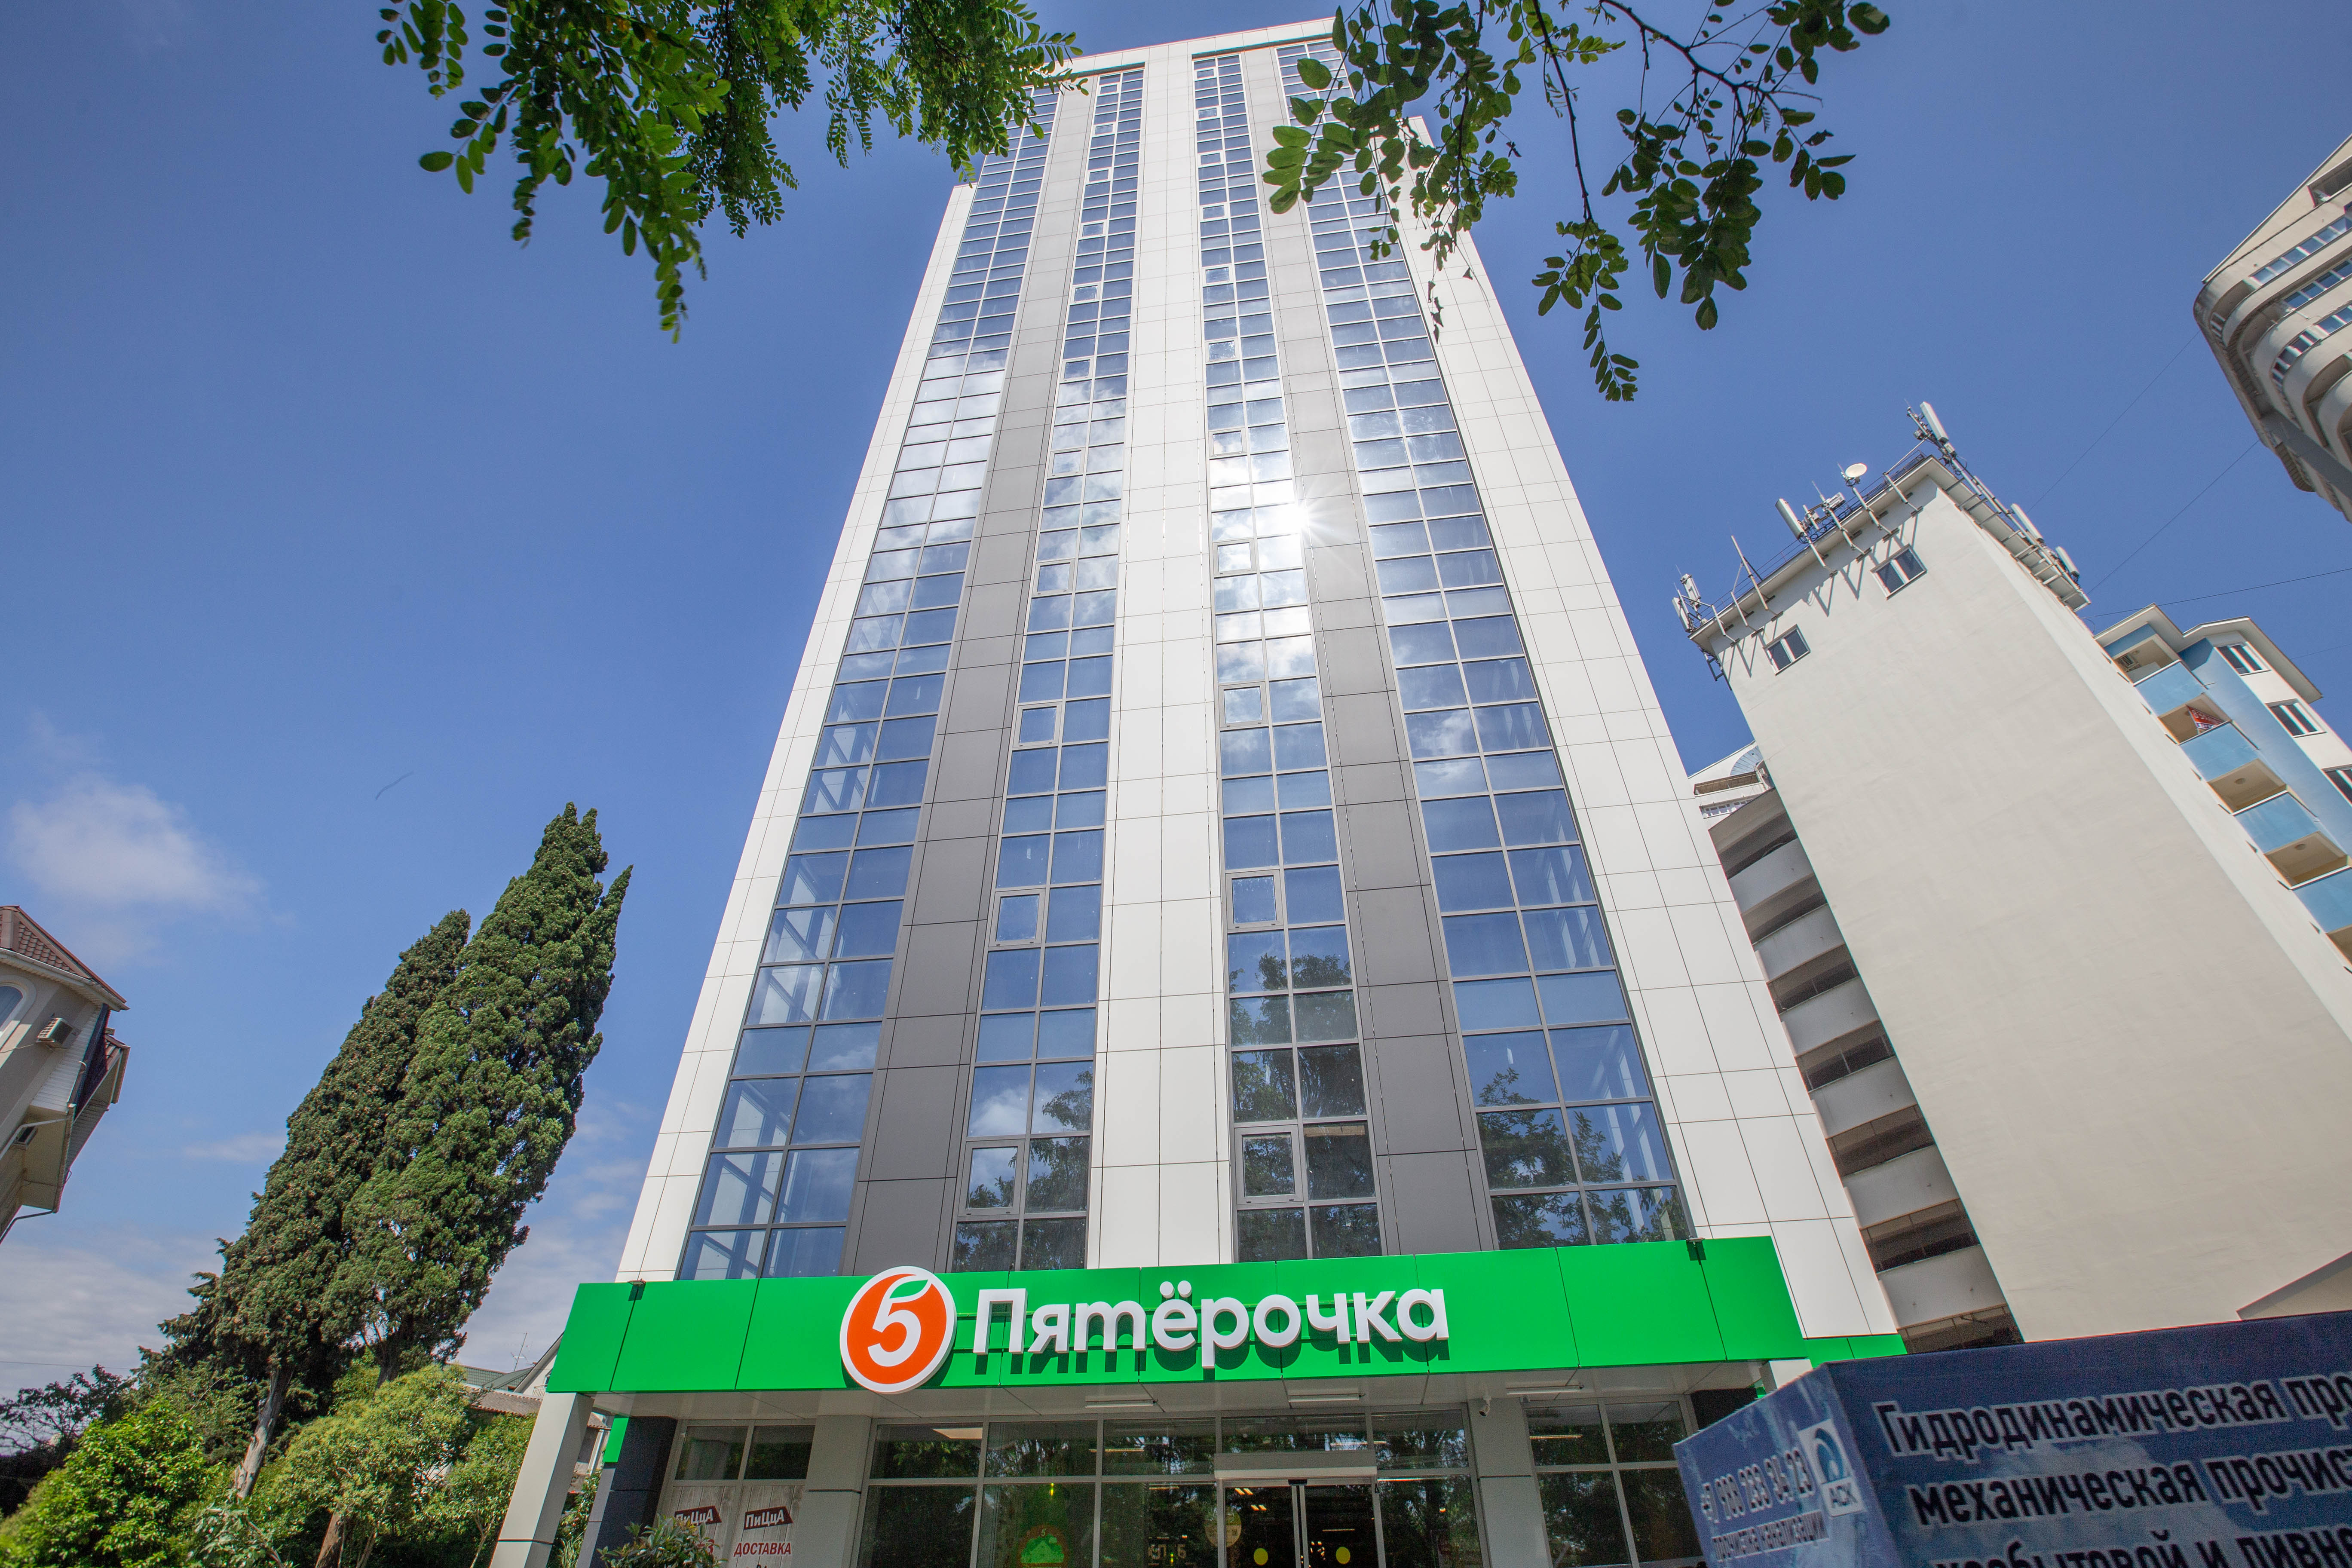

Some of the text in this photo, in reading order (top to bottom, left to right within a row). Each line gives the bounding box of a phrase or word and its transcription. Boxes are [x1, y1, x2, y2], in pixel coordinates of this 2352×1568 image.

[973, 1280, 1449, 1369] Пятёрочка
[1875, 1382, 2288, 1460] Гидродинамическая
[1908, 1464, 2209, 1525] механическая
[733, 1542, 787, 1557] ДОСТАВКА
